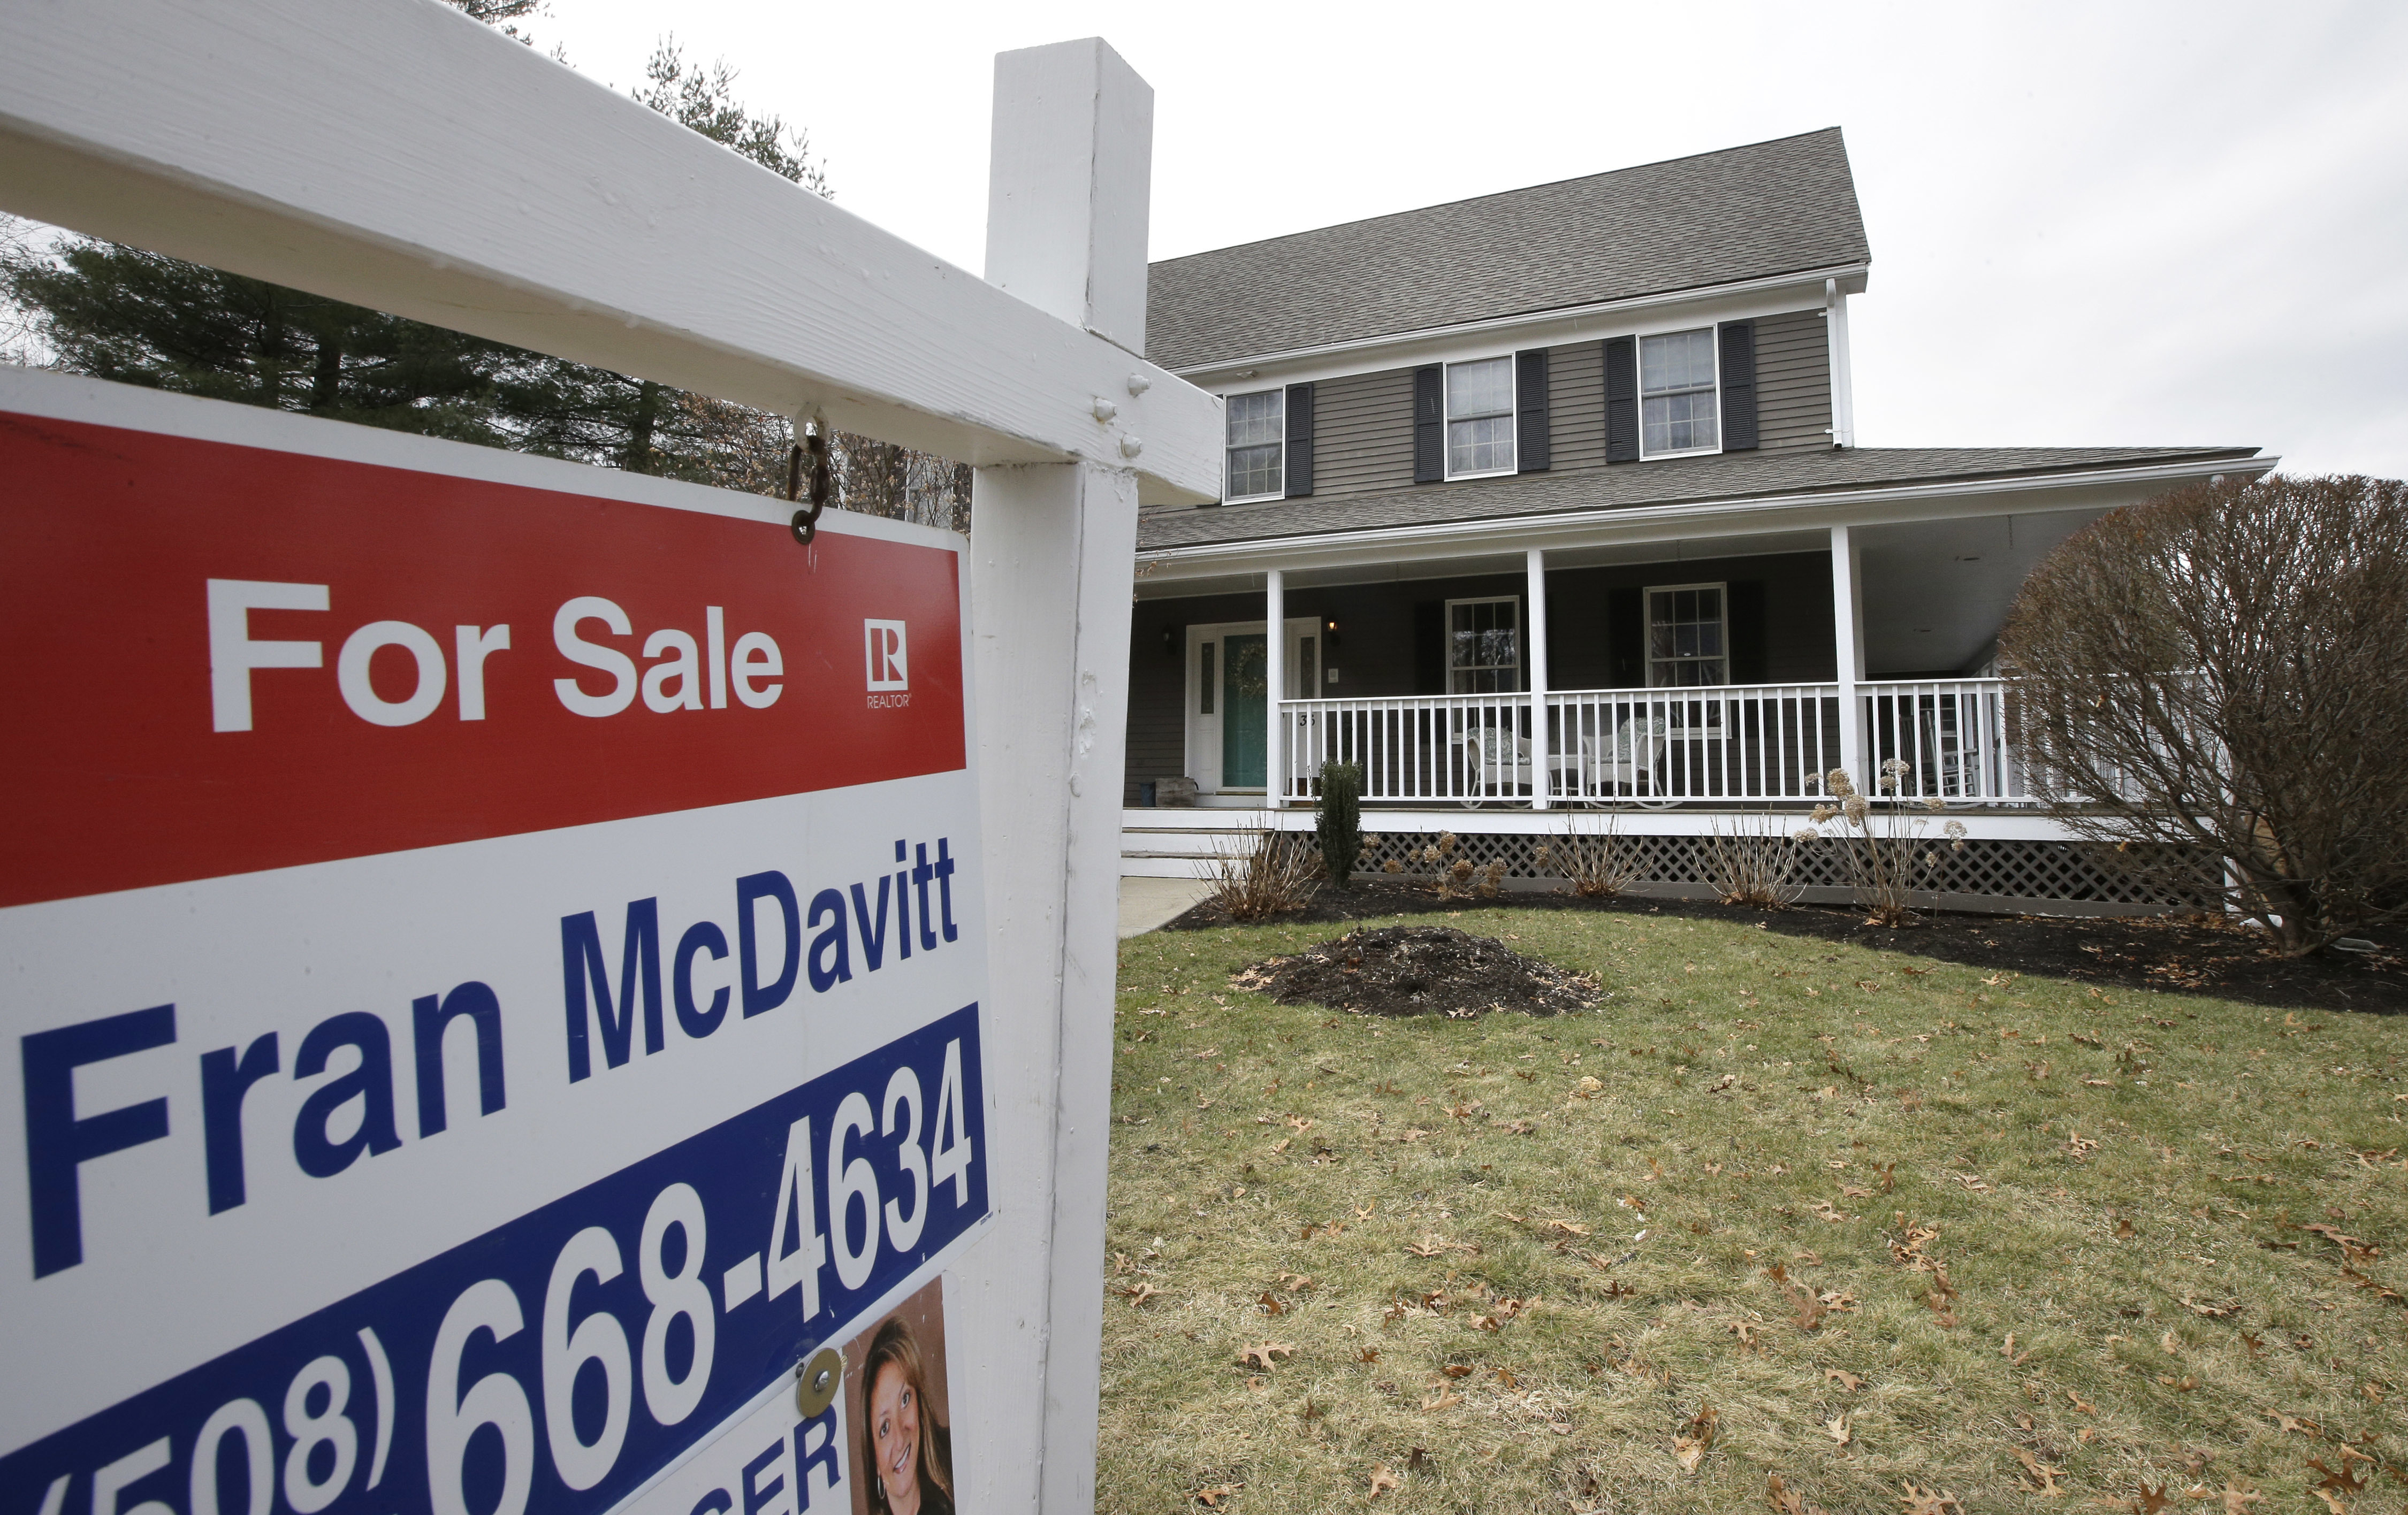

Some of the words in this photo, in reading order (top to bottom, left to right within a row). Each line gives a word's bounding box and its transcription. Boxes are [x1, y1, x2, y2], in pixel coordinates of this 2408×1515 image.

[208, 579, 510, 732] For
[553, 596, 784, 717] Sale
[22, 981, 506, 1279] Fran
[561, 838, 958, 1084] McDavitt
[426, 1037, 972, 1515] 668-4634
[689, 1403, 841, 1515] ER
